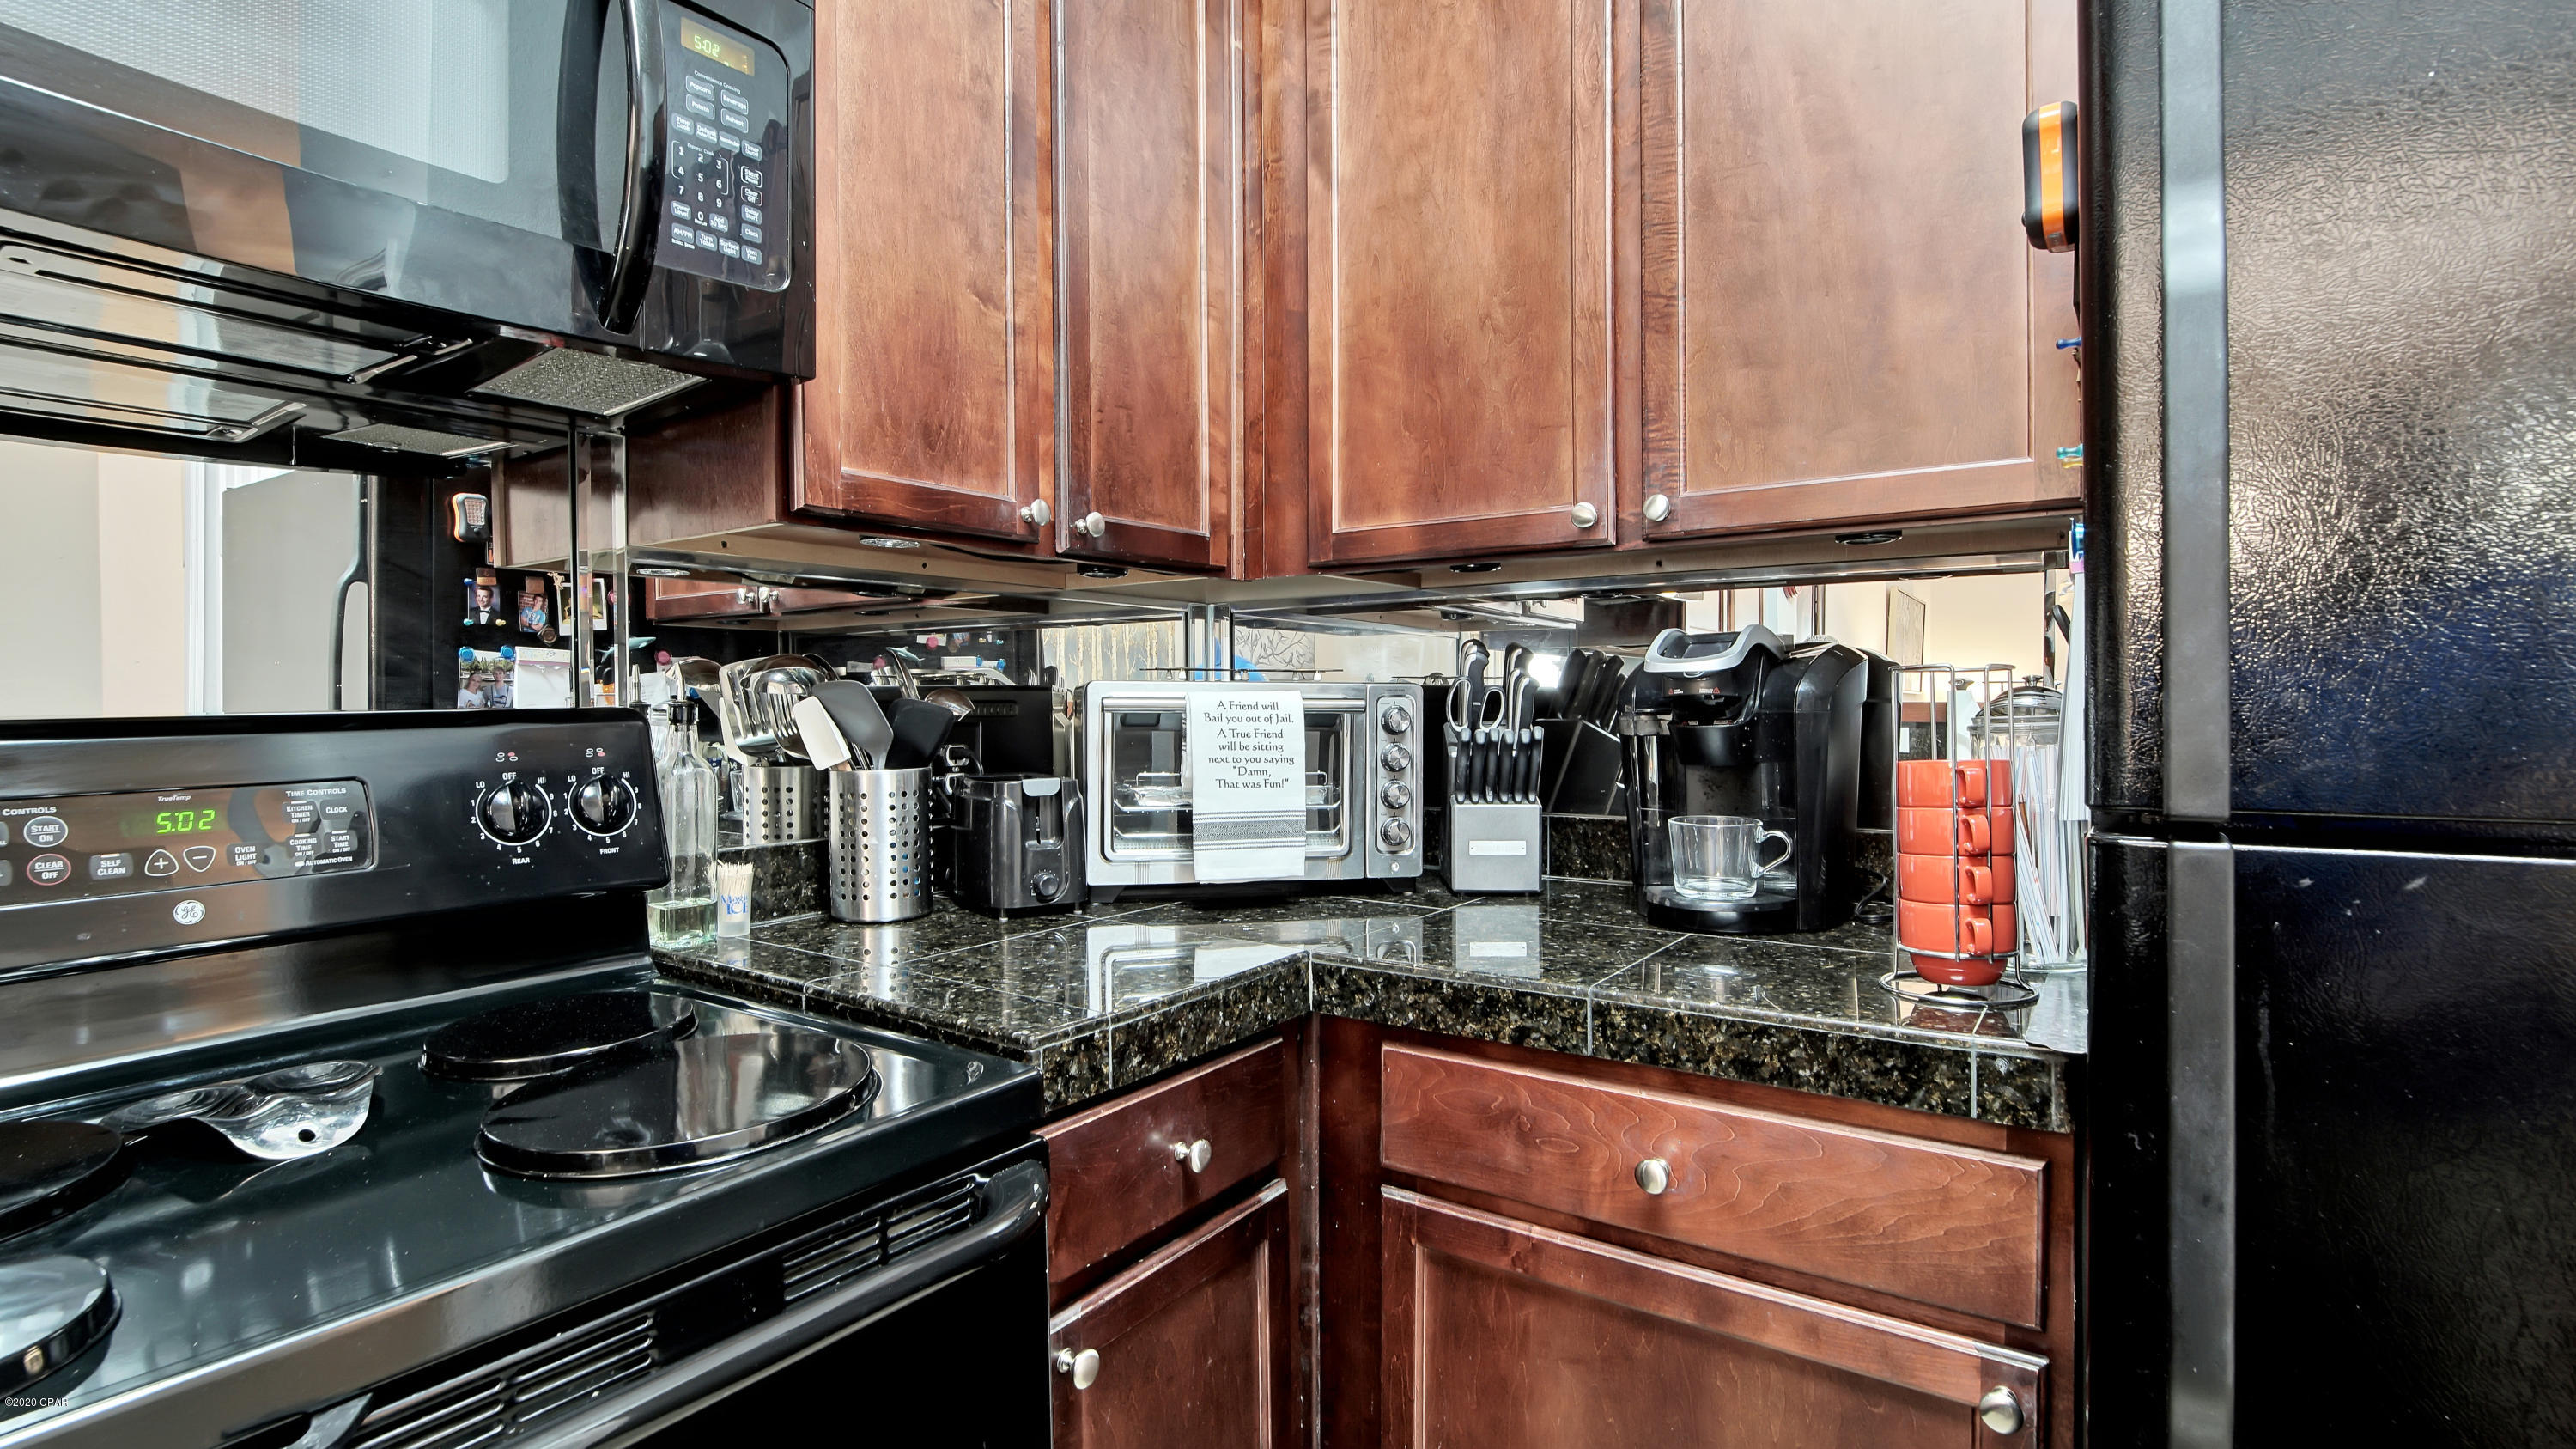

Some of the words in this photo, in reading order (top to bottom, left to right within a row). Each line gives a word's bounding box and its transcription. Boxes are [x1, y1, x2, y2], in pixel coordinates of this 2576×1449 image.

[690, 81, 712, 95] Popcorn
[723, 82, 741, 94] Cooking
[691, 100, 710, 113] Potato
[723, 94, 747, 110] Beverage
[676, 116, 690, 126] Time
[726, 114, 744, 127] Reheat
[676, 122, 690, 131] Cook
[696, 125, 717, 136] Defrost
[687, 143, 703, 153] Express
[703, 149, 714, 157] Cook
[744, 143, 760, 153] Timer
[678, 146, 684, 156] 1
[697, 153, 704, 164] 2
[715, 159, 722, 170] 3
[677, 166, 685, 176] 4
[697, 172, 704, 182] 5
[715, 179, 722, 189] 6
[744, 167, 760, 179] Start
[678, 185, 684, 195] 7
[697, 192, 704, 202] 8
[715, 198, 722, 208] 9
[744, 187, 758, 197] Clear
[672, 202, 690, 212] Power
[744, 207, 760, 216] Delay
[673, 208, 690, 218] Level
[697, 211, 704, 221] 0
[744, 213, 759, 222] Start
[714, 216, 725, 224] Add
[673, 228, 693, 239] AM/PM
[700, 233, 714, 242] Turn
[744, 228, 759, 238] Clock
[699, 238, 714, 248] Table
[720, 240, 740, 250] Surface
[723, 245, 737, 255] Light
[745, 247, 758, 257] Vent
[1216, 700, 1227, 711] A
[1229, 700, 1259, 711] Friend
[1261, 701, 1279, 711] will
[1204, 712, 1224, 723] Bail
[1225, 715, 1243, 725] you
[1245, 714, 1262, 723] out
[1263, 713, 1273, 725] of
[1275, 714, 1295, 724] Jail.
[1216, 728, 1227, 739] A
[1228, 728, 1252, 739] True
[1254, 728, 1284, 739] Friend
[1218, 740, 1237, 752] will
[1238, 740, 1250, 752] be
[1252, 741, 1285, 753] sitting
[1207, 755, 1230, 764] next
[1231, 755, 1242, 764] to
[1244, 756, 1262, 765] you
[1263, 754, 1295, 765] saying
[591, 766, 605, 775] OFF
[1232, 765, 1273, 778] "Damn,
[502, 771, 517, 781] OFF
[1215, 778, 1241, 789] That
[1263, 777, 1290, 789] Fun!"
[285, 789, 305, 798] TIME
[307, 788, 347, 796] CONTROLS
[157, 795, 192, 803] TrueTemp
[2, 806, 58, 817] CONTROLS
[286, 805, 313, 813] KITCHEN
[325, 806, 348, 814] CLOCK
[156, 808, 216, 834] 5:02
[30, 824, 61, 833] START
[39, 834, 54, 843] ON
[289, 837, 317, 846] COOKING
[234, 845, 256, 854] OVEN
[234, 853, 257, 861] LIGHT
[305, 857, 337, 867] AUTOMATIC
[34, 861, 64, 870] CLEAR
[100, 859, 122, 868] SELF
[41, 871, 58, 880] OFF
[97, 867, 126, 876] CLEAN
